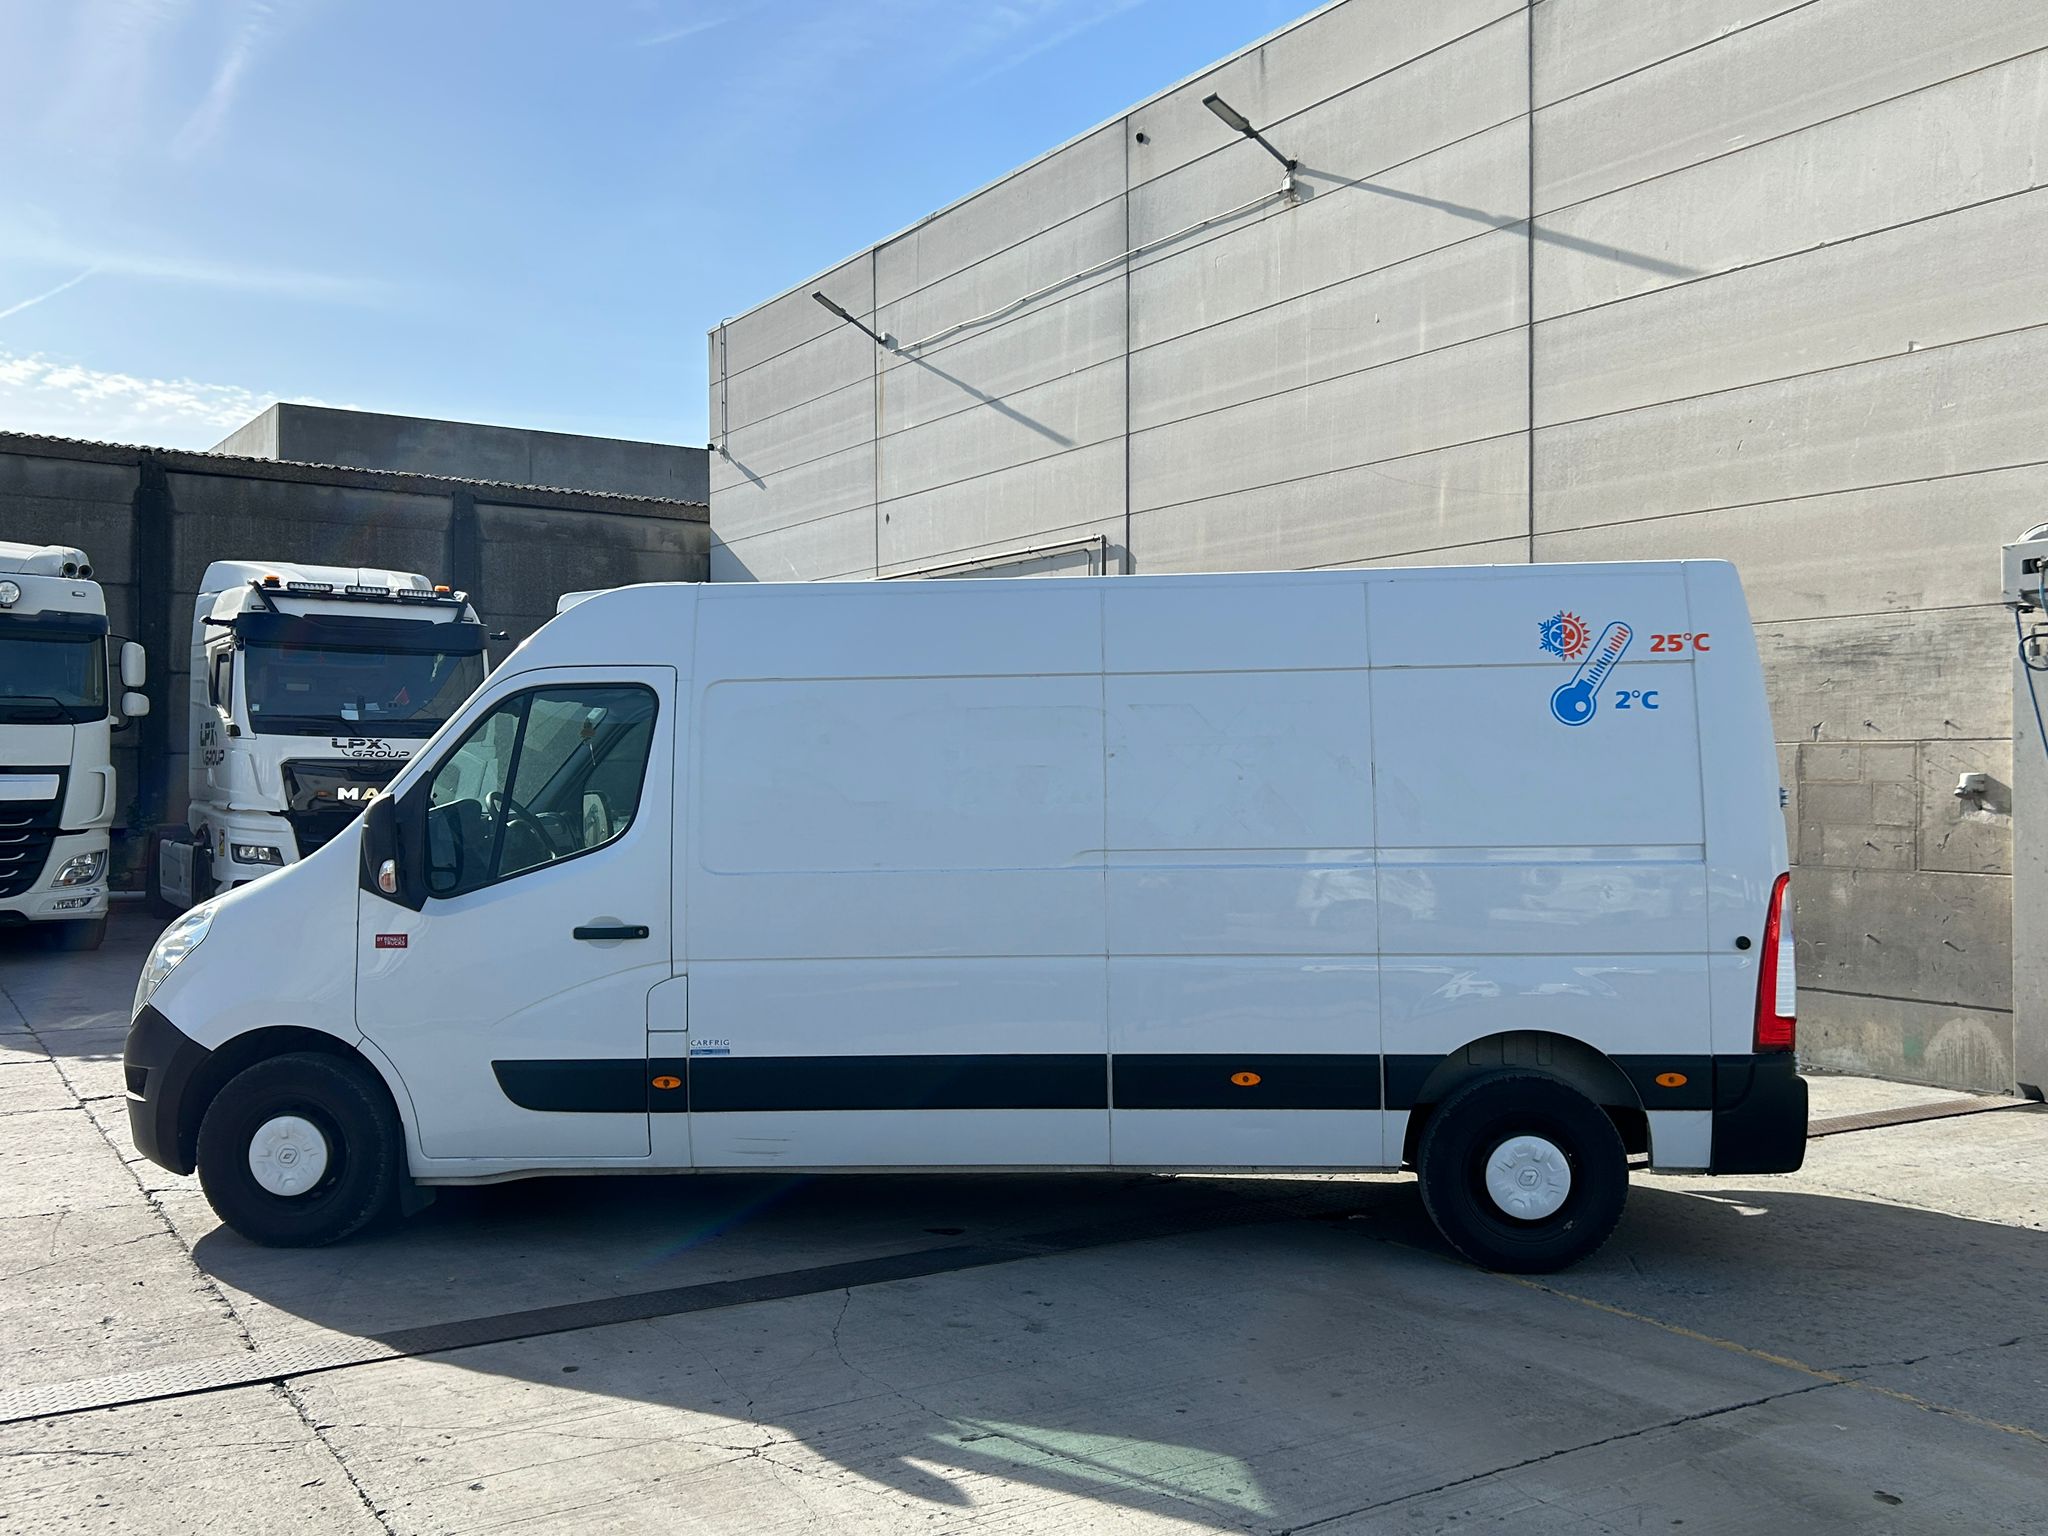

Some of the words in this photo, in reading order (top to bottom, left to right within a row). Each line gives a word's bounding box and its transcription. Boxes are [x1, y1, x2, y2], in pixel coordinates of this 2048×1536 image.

[1650, 633, 1710, 652] 25°C
[1615, 690, 1659, 709] 2°C
[200, 721, 216, 747] LPX
[331, 737, 382, 749] LPX
[351, 750, 410, 758] GROUP
[337, 787, 381, 800] MA
